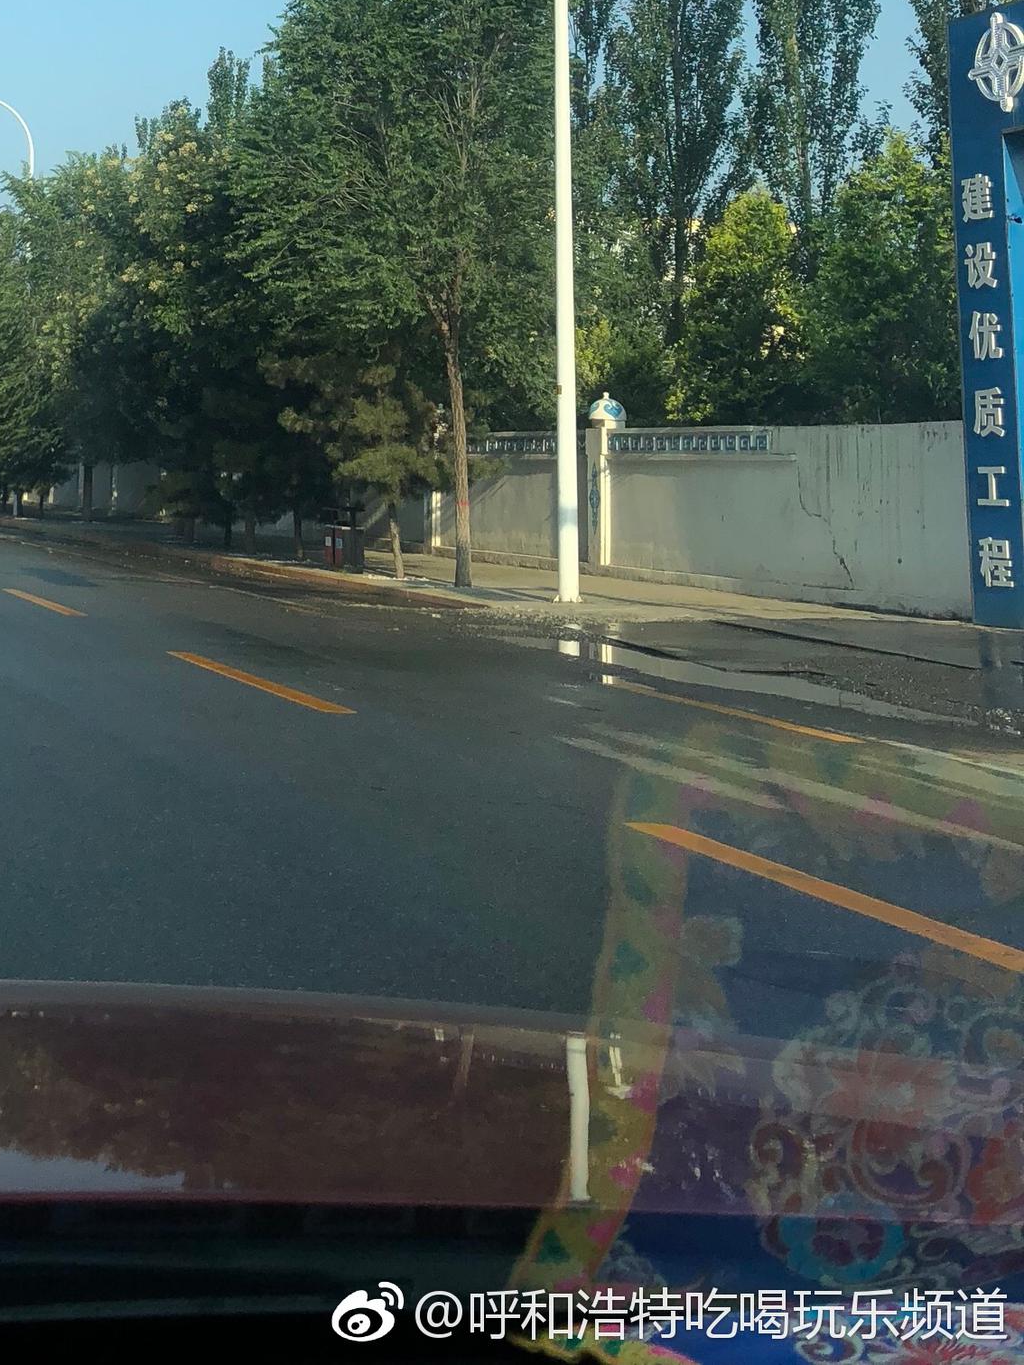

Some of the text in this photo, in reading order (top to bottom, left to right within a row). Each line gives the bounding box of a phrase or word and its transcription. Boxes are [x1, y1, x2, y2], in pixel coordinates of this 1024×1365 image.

[960, 172, 1015, 590] 建设优质工程
